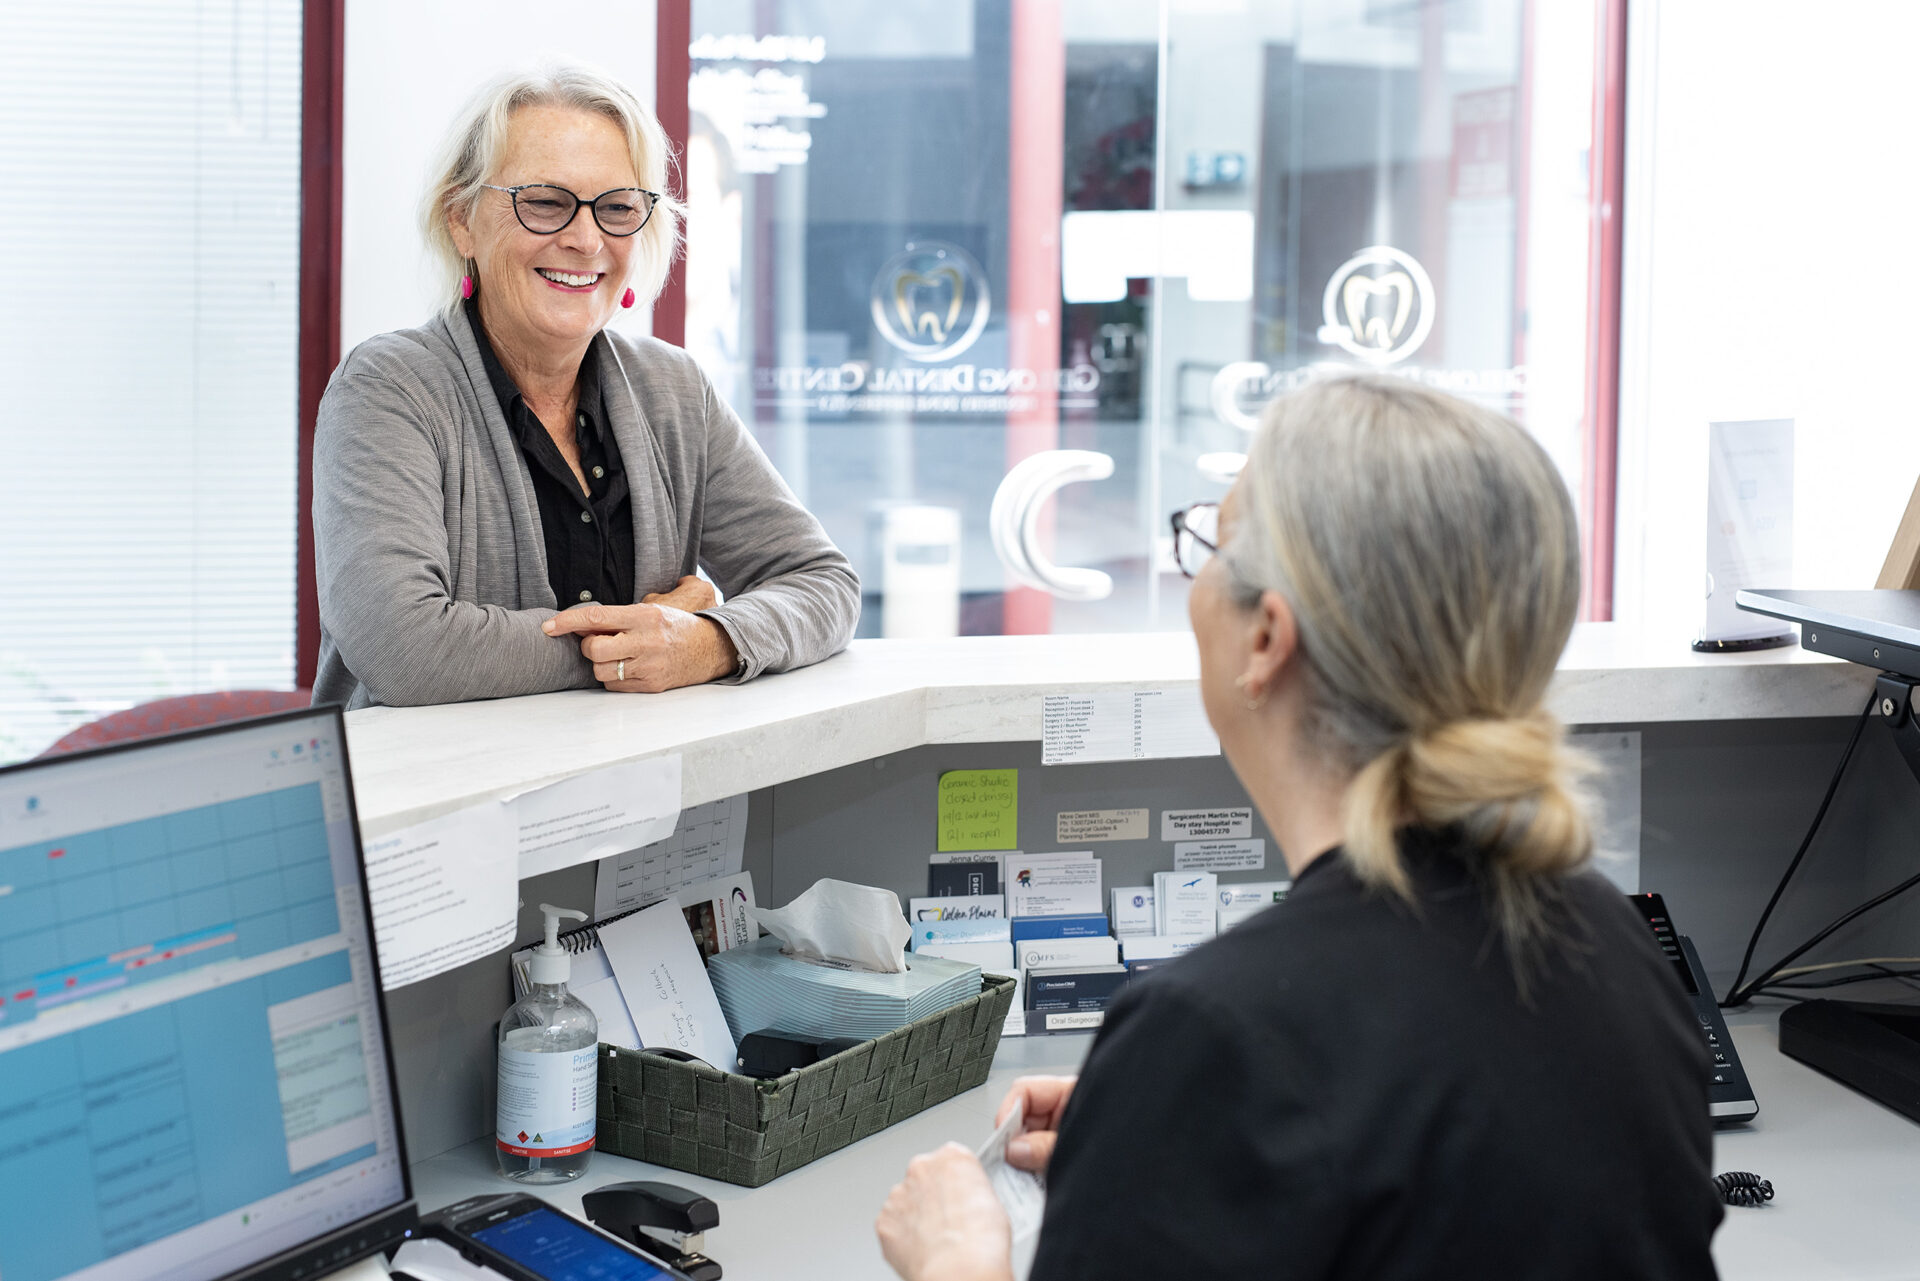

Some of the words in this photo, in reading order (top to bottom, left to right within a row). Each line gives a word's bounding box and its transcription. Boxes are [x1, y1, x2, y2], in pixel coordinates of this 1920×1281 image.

[982, 810, 1000, 823] day
[949, 855, 972, 863] Jenna
[942, 906, 967, 920] Golden
[969, 905, 997, 920] Plains
[739, 905, 749, 944] cerami
[1068, 1016, 1100, 1024] Surgeons
